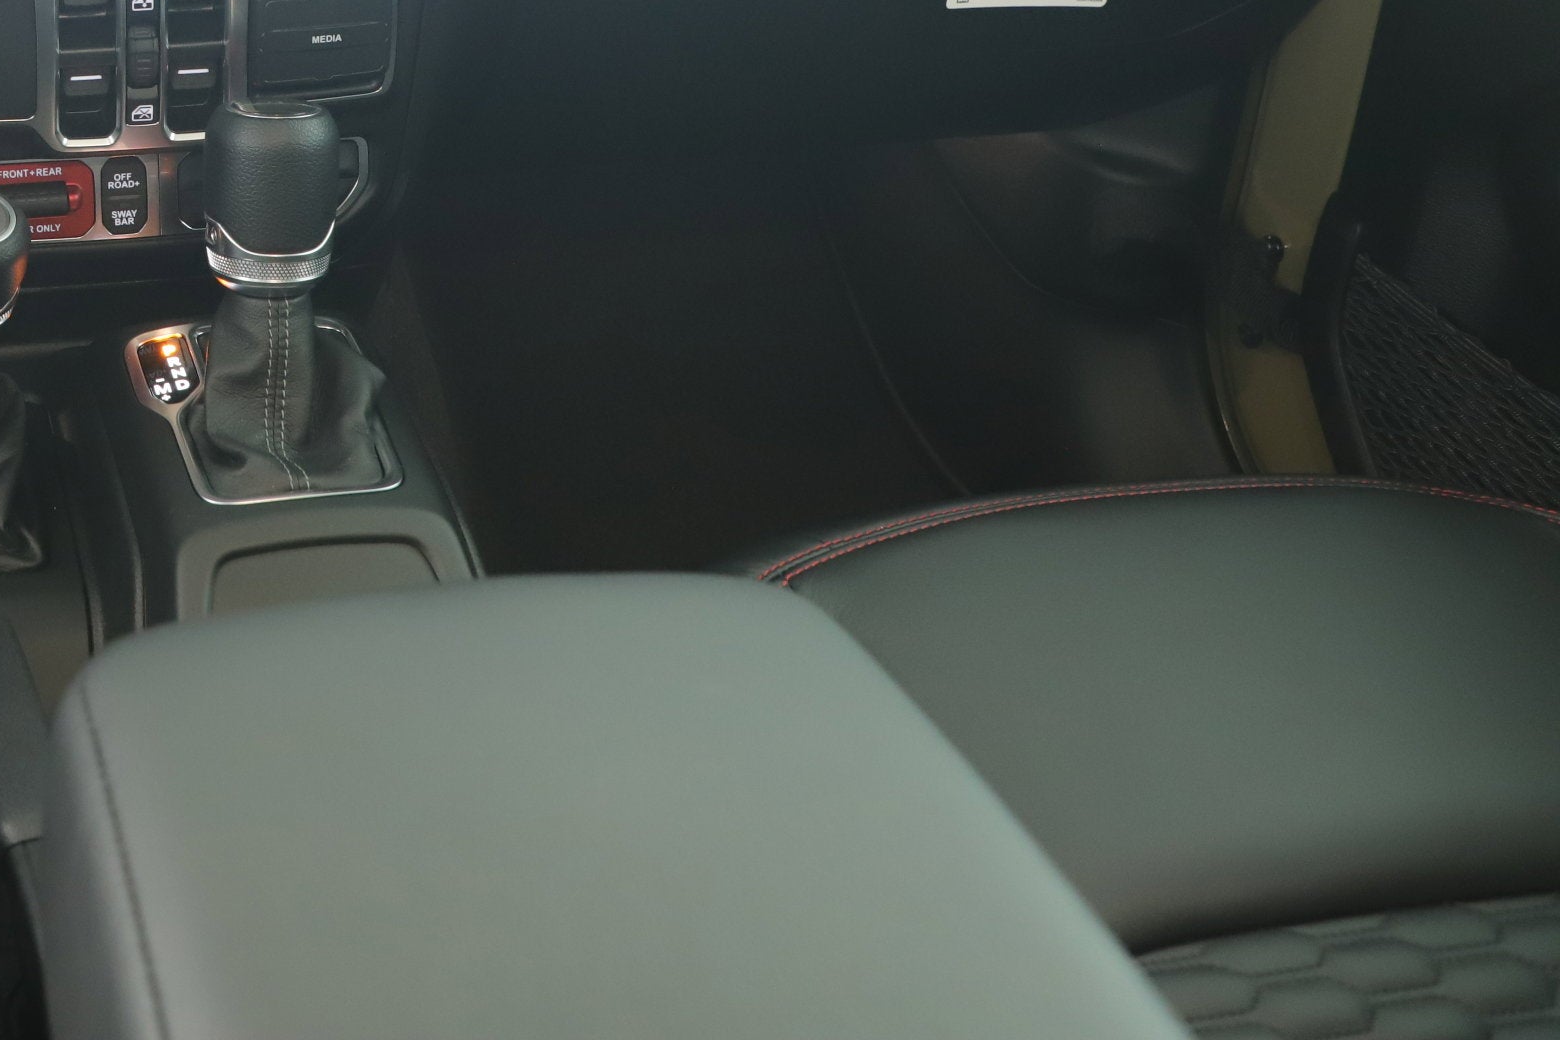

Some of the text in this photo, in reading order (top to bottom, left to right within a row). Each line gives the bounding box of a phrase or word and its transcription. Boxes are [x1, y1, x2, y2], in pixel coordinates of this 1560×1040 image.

[311, 33, 343, 44] MEDIA
[113, 172, 132, 181] OFF
[107, 180, 140, 190] ROAD+
[111, 209, 138, 219] SWAY
[114, 217, 135, 226] BAR
[36, 223, 62, 234] ONLY
[166, 356, 181, 368] R
[171, 367, 187, 379] N
[154, 382, 172, 396] M
[175, 379, 190, 391] D
